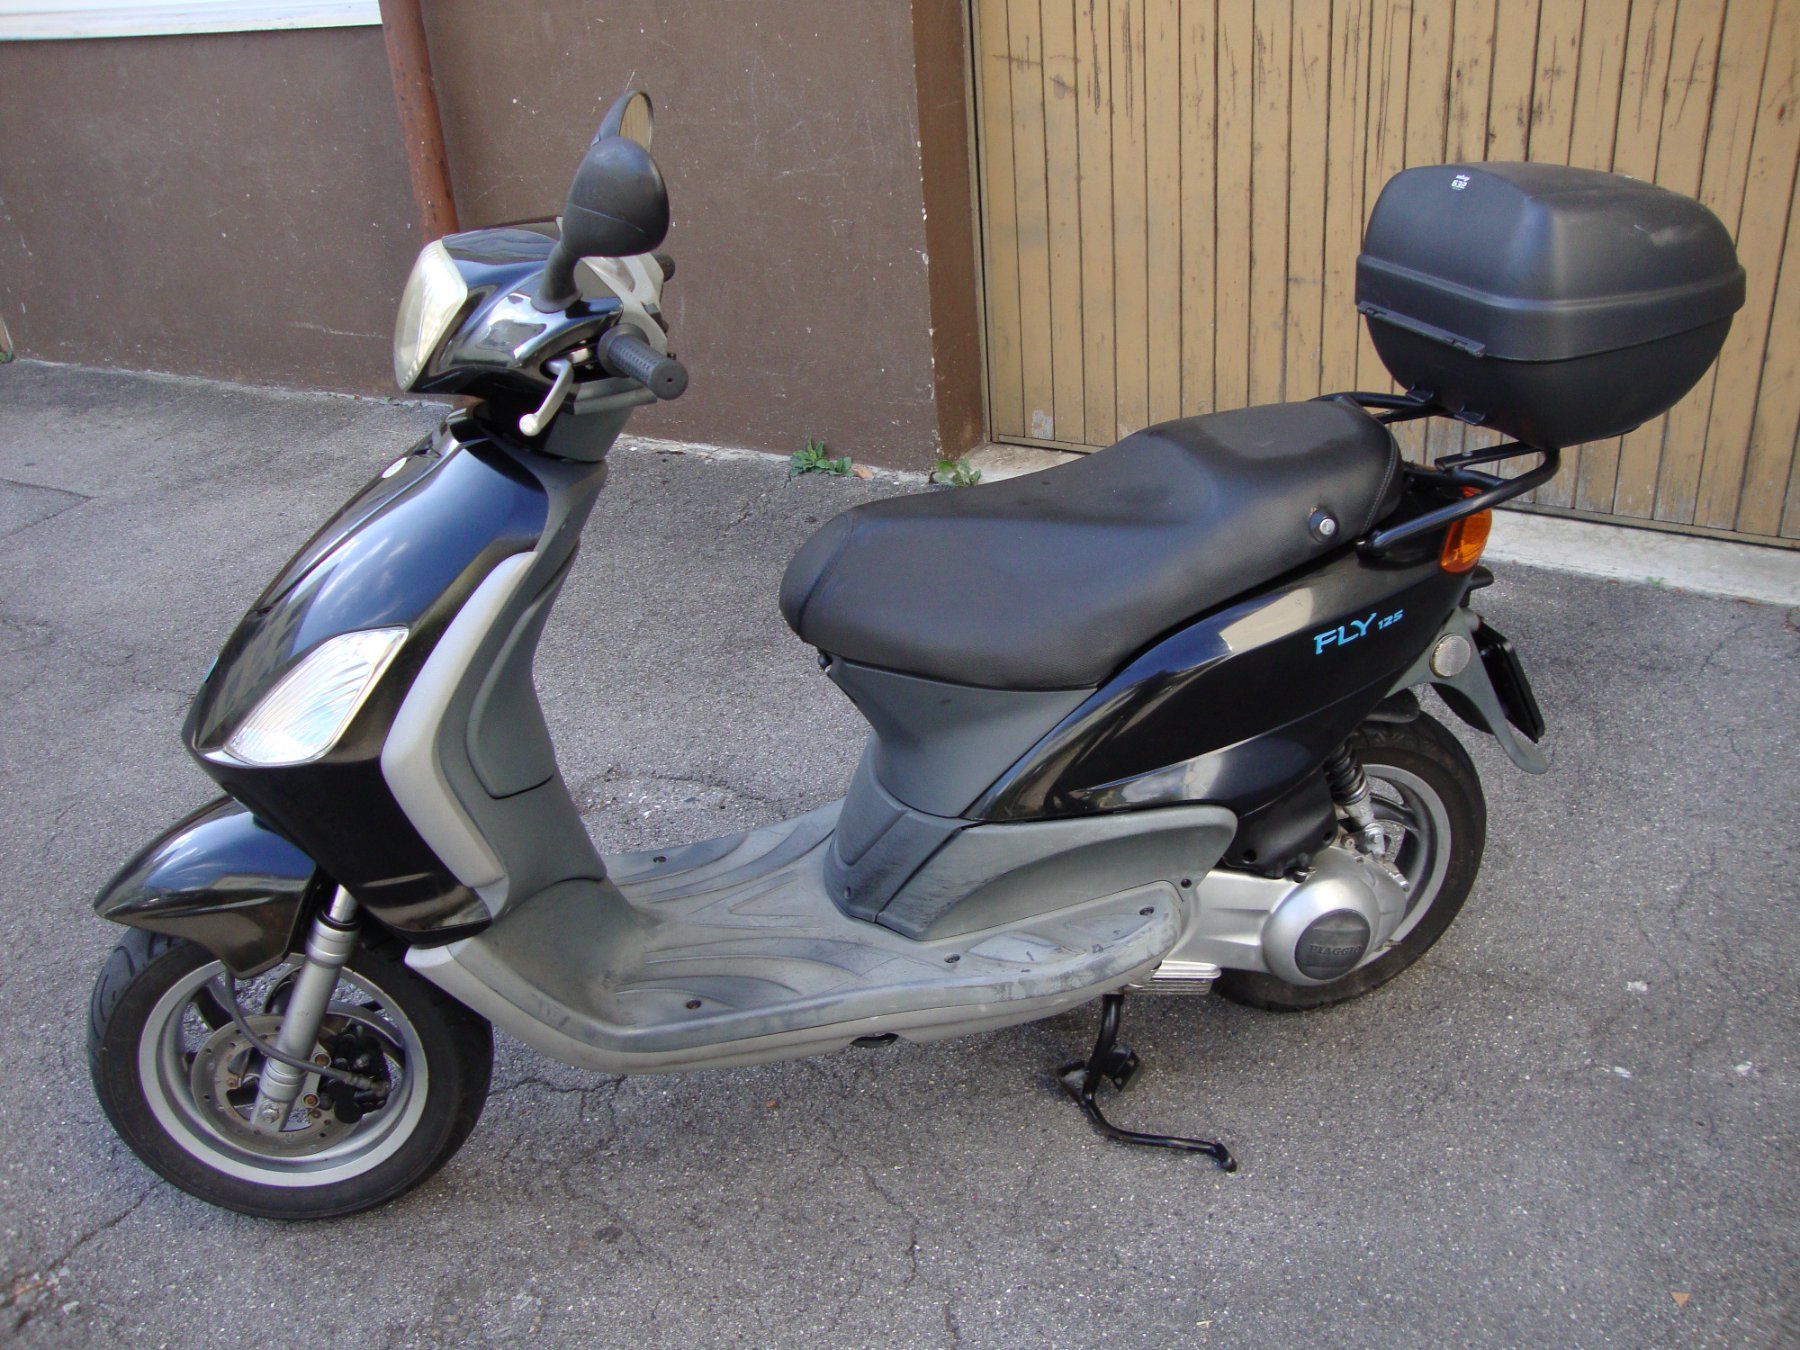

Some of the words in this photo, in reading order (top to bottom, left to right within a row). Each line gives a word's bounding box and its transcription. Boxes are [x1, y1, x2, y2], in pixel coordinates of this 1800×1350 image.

[1313, 612, 1377, 655] FLY
[1378, 609, 1404, 630] 125
[1309, 944, 1361, 956] PIAGGIO
